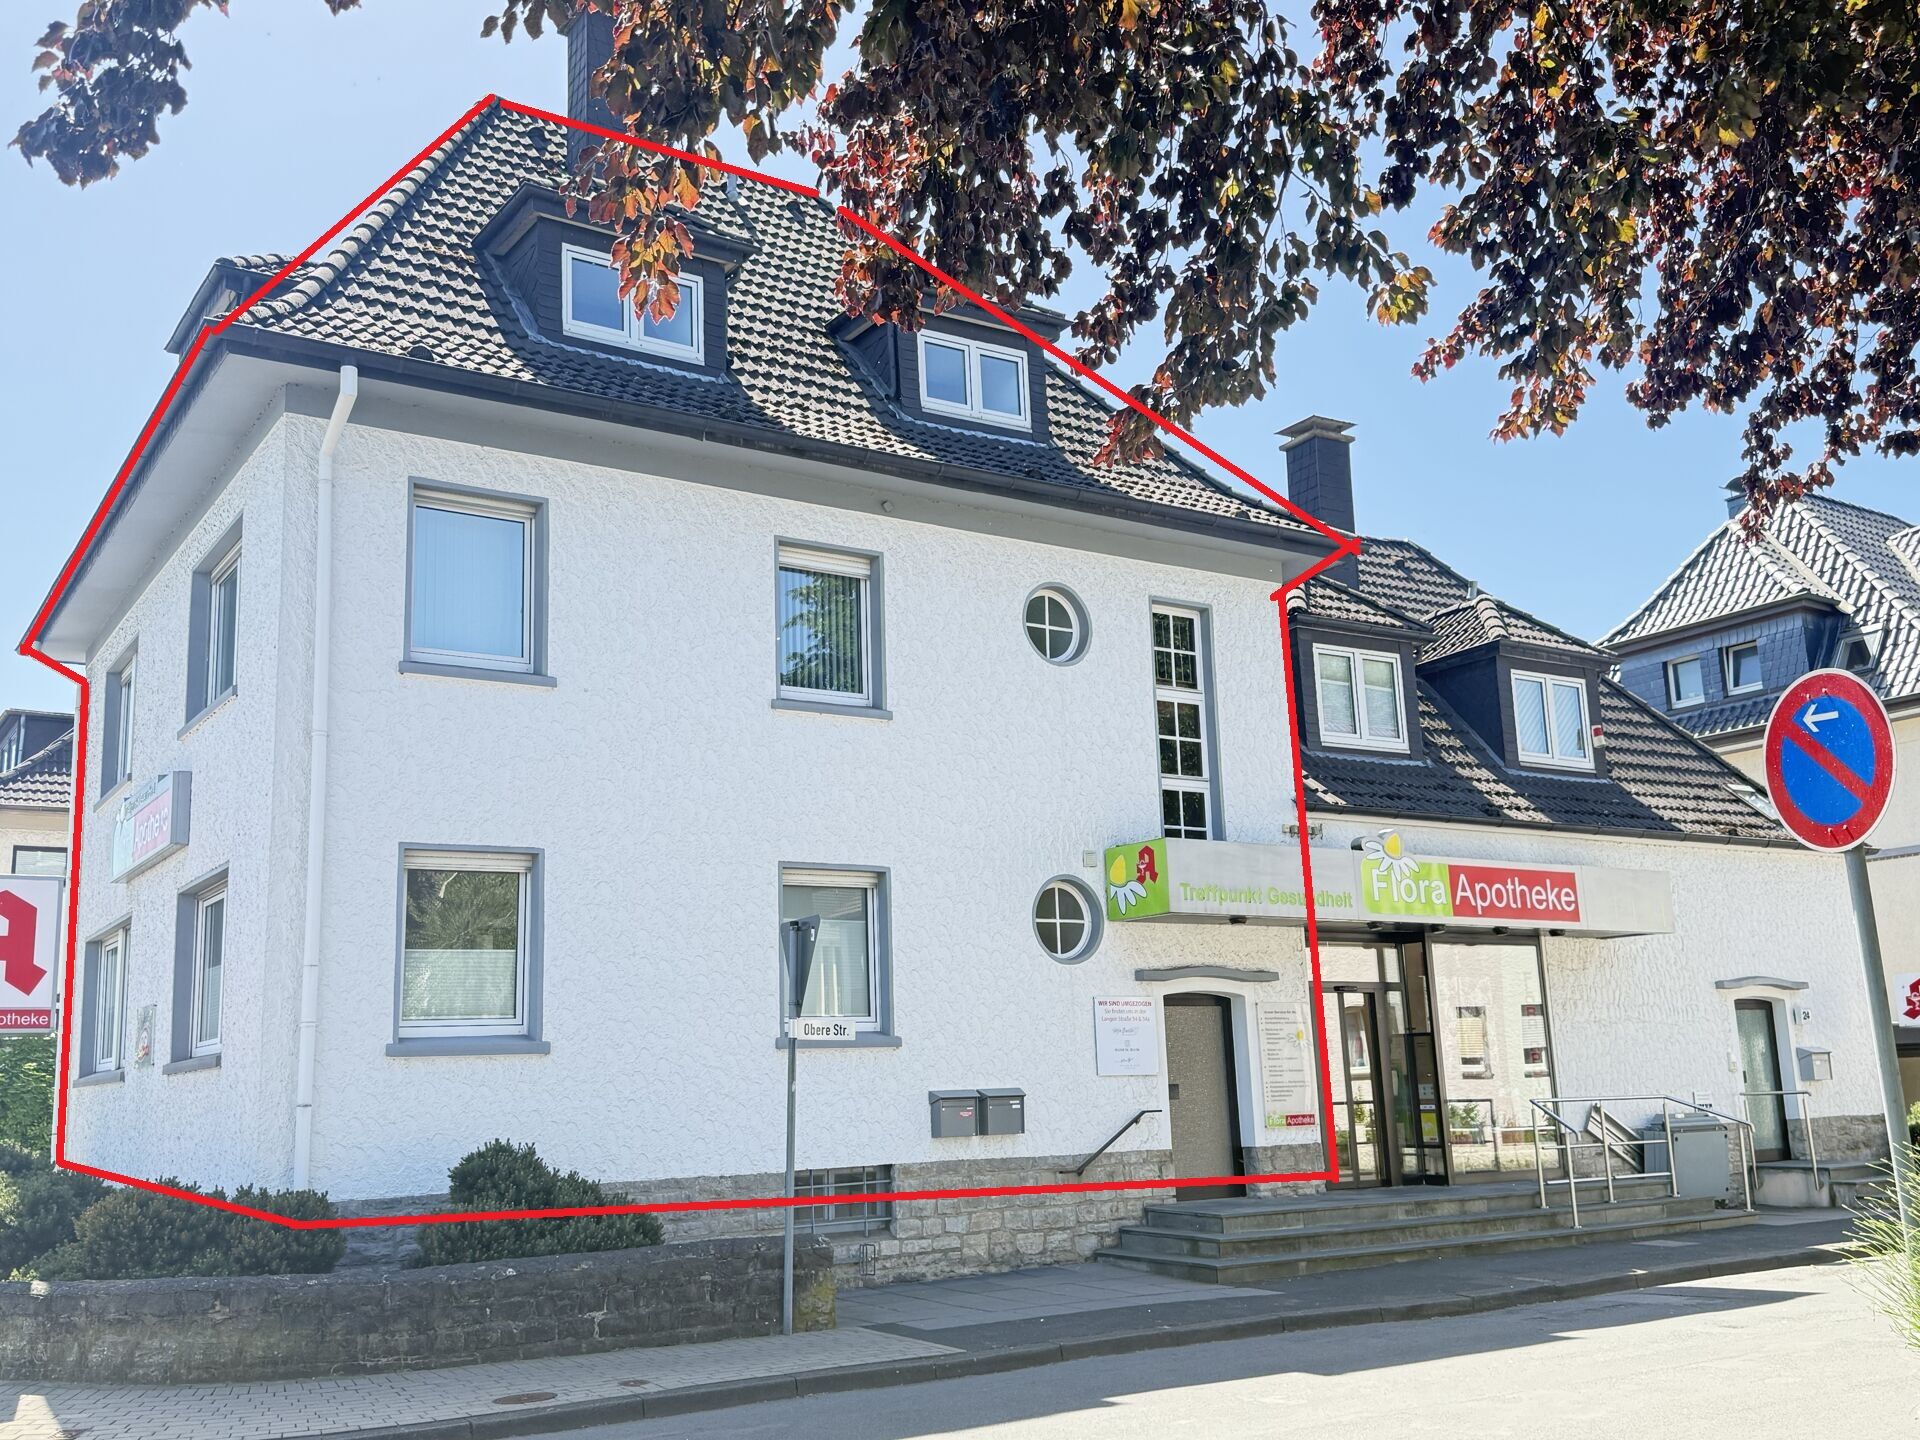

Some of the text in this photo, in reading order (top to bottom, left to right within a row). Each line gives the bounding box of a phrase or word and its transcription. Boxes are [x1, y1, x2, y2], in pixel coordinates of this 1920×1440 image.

[1180, 881, 1353, 909] Treffpunkt Gesudheit
[1370, 868, 1577, 915] Flora Apotheke
[1802, 1011, 1811, 1020] 24
[804, 1023, 850, 1036] Obere Str.
